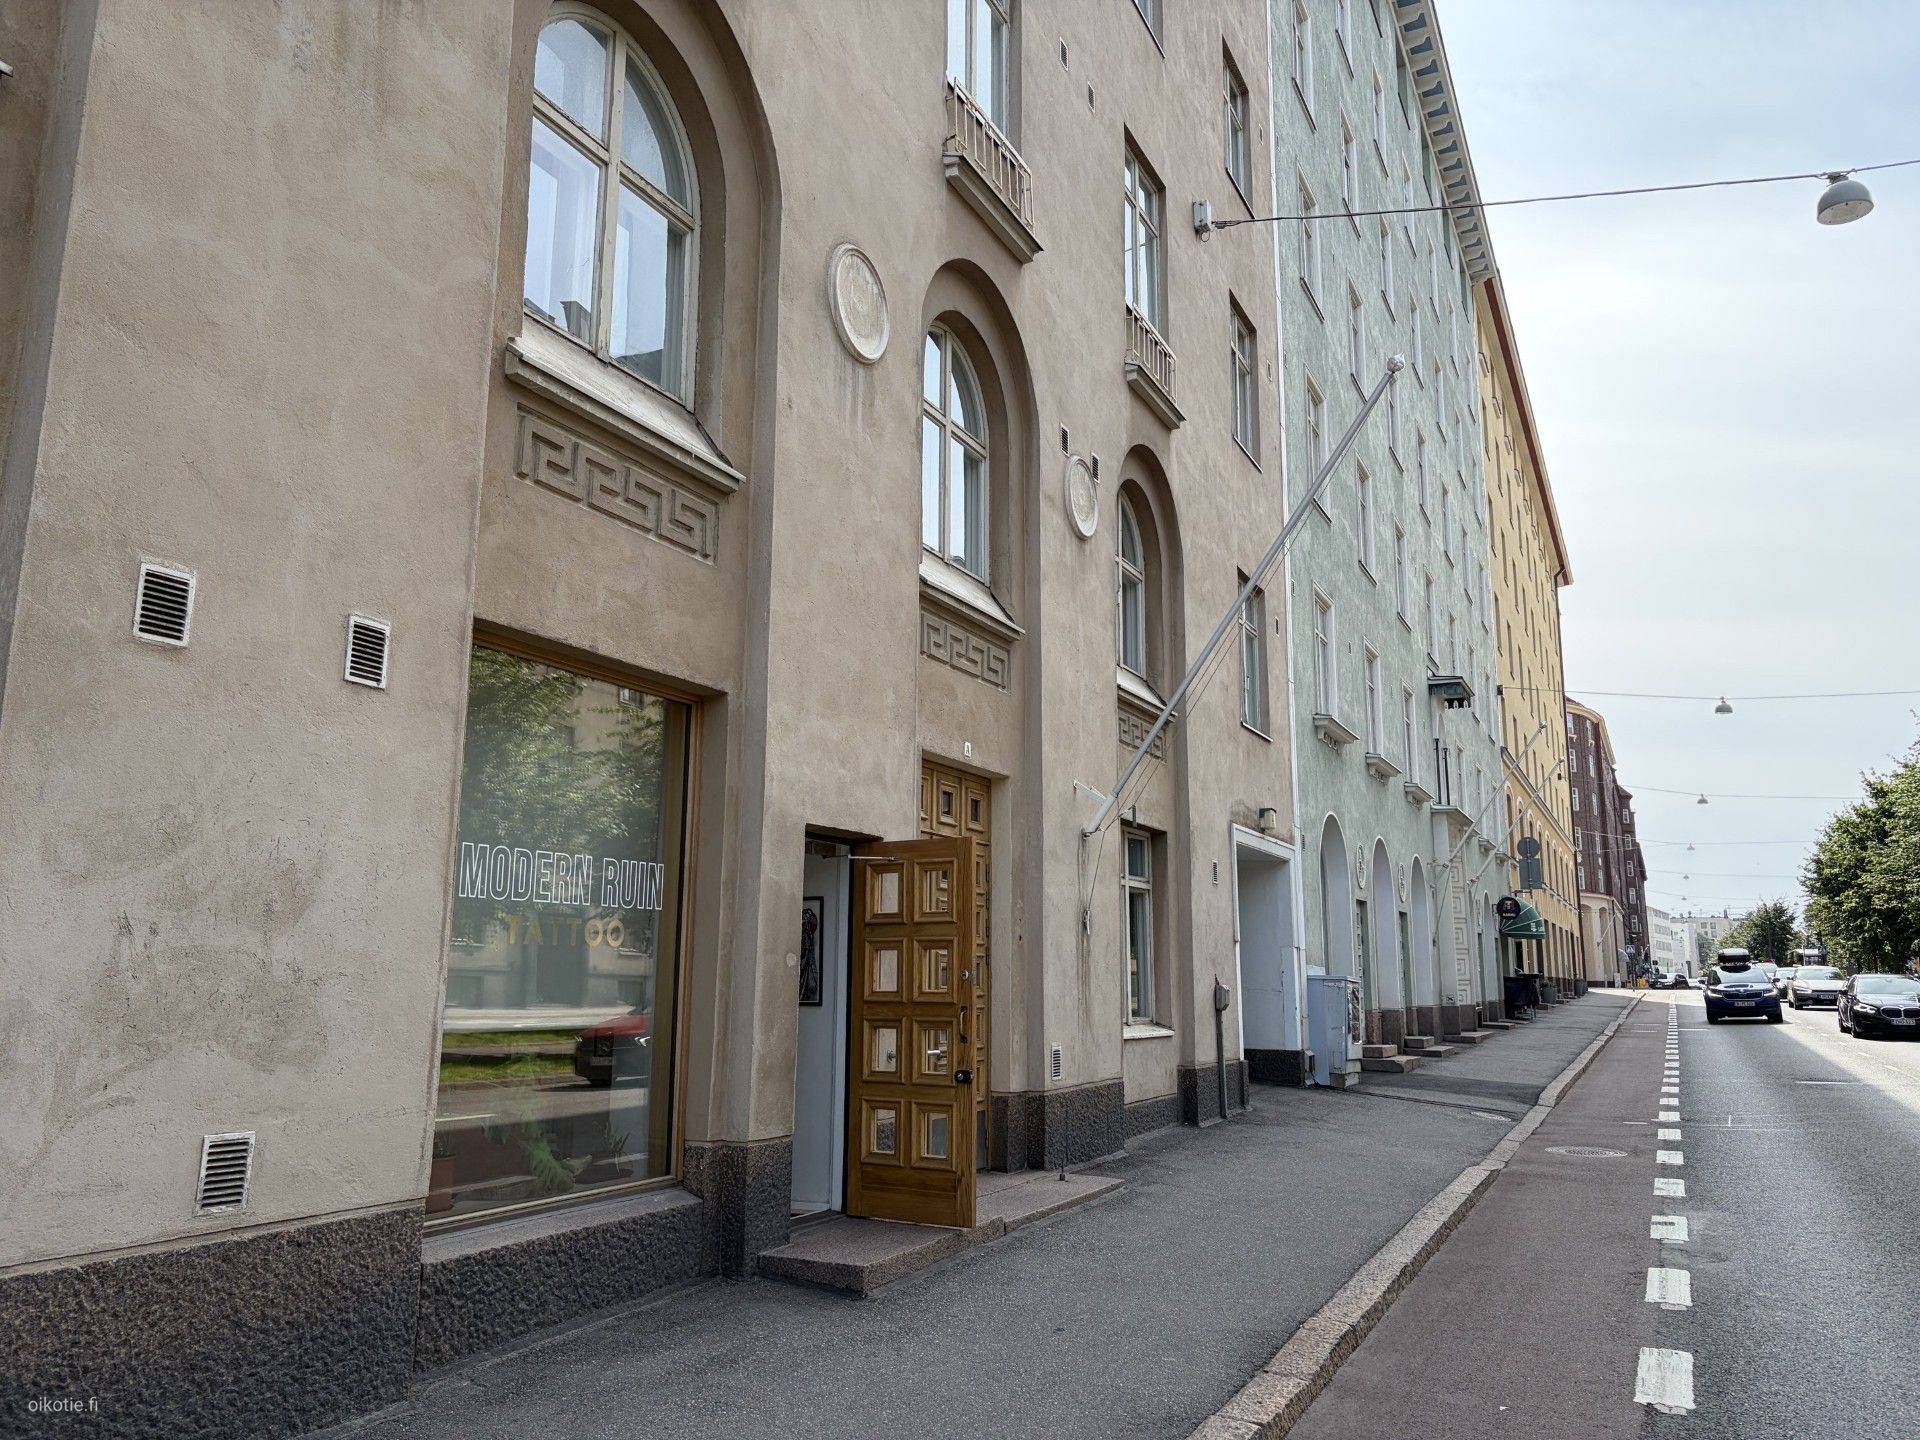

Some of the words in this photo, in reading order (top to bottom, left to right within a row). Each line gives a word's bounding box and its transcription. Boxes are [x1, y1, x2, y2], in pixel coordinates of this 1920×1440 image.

[459, 841, 593, 905] MODERN
[601, 857, 665, 910] RUIN
[505, 916, 625, 948] TATTOO
